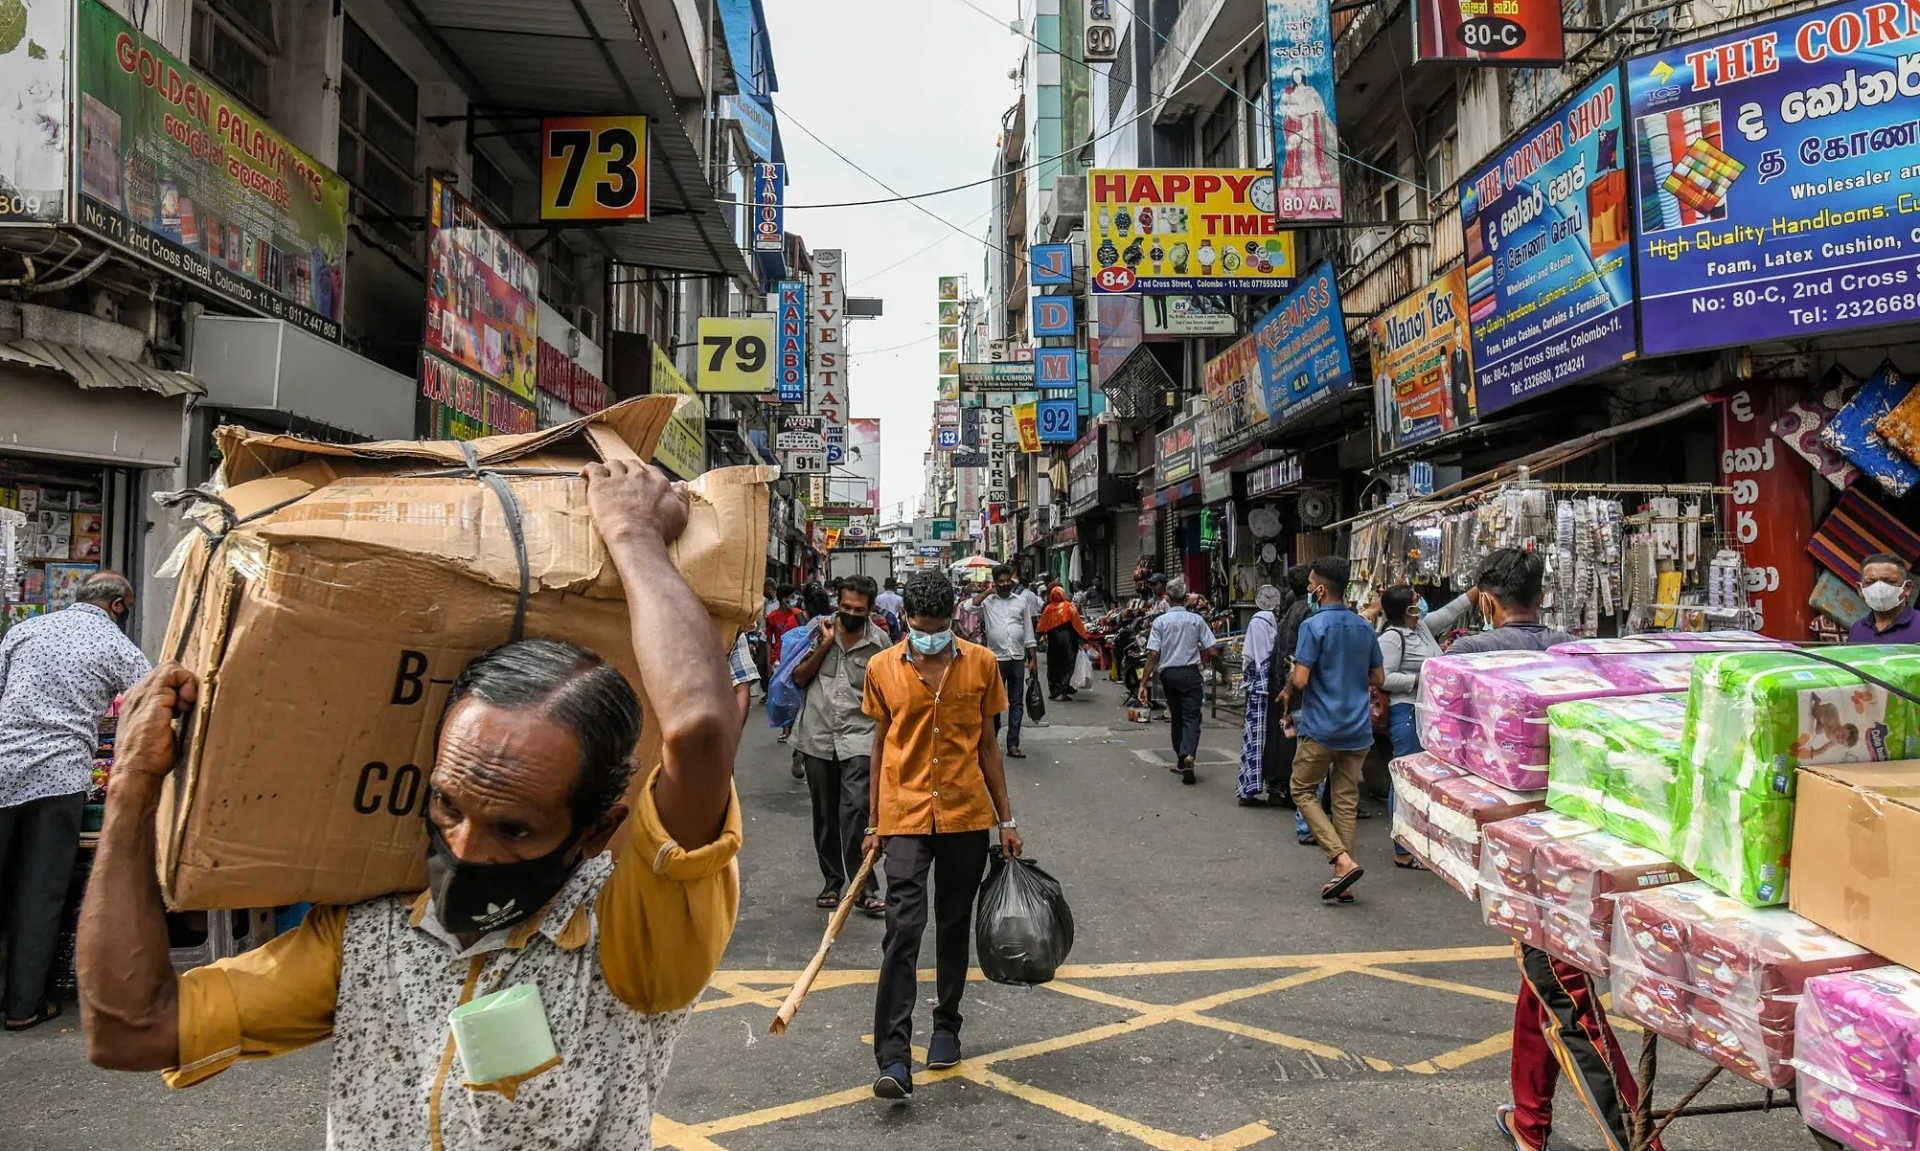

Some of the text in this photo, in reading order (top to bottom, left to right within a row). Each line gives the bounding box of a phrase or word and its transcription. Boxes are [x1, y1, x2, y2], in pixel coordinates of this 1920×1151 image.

[1090, 30, 1112, 50] 90
[1464, 24, 1518, 45] 80-C
[116, 32, 211, 127] GOLDEN
[1685, 32, 1779, 92] THE
[1737, 101, 1768, 142] ද
[1475, 83, 1615, 211] THE CORNER SHOP
[1758, 120, 1920, 184] த கோண
[549, 127, 638, 209] 73
[1790, 167, 1891, 200] Wholesaler
[761, 164, 778, 222] RADO
[1094, 174, 1255, 204] HAPPY
[1283, 195, 1336, 211] 80 A/A
[1201, 214, 1280, 237] TIME
[1650, 236, 1690, 261] High
[1696, 224, 1765, 251] Quality
[86, 204, 106, 230] No:
[109, 216, 126, 242] 71,
[129, 227, 150, 251] 2nd
[152, 239, 181, 267] Cross
[183, 254, 212, 284] Street,
[215, 271, 252, 300] Colombo
[288, 306, 302, 322] 011
[309, 316, 323, 332] 447
[323, 322, 336, 339] 809
[1507, 253, 1574, 297] Wholesaler and Retailer
[1707, 258, 1757, 277] Foam,
[1764, 249, 1813, 268] Latex
[1821, 233, 1902, 259] Cushion,
[1102, 271, 1130, 286] 84
[1152, 279, 1170, 288] Cross
[1171, 279, 1193, 289] Street,
[1197, 279, 1223, 288] Colombo
[1251, 279, 1289, 288] 0775558358
[1692, 269, 1908, 314] No: 80-C, 2nd Cross
[783, 291, 801, 384] KANABO
[1385, 302, 1426, 355] Manoj
[1427, 288, 1455, 331] Tex
[1486, 291, 1610, 357] Foam, Latex Cushion, Curtains & Furnishing
[1788, 307, 1829, 327] Tel:
[703, 335, 767, 373] 79
[818, 272, 839, 424] FIVE STAR
[941, 281, 956, 395] RAMYA
[1482, 316, 1622, 386] No: 80-C, 2nd Cross Street, Colombo-11.
[423, 355, 453, 408] M.N.
[456, 373, 483, 422] SHA
[1510, 381, 1523, 396] Tel:
[1555, 355, 1585, 379] 2324241
[784, 418, 815, 428] AVON
[1042, 408, 1071, 433] 92
[1731, 390, 1755, 422] ද
[938, 432, 956, 444] 132
[796, 456, 814, 469] 91
[991, 432, 1004, 487] CENTRE
[990, 491, 1005, 500] 106
